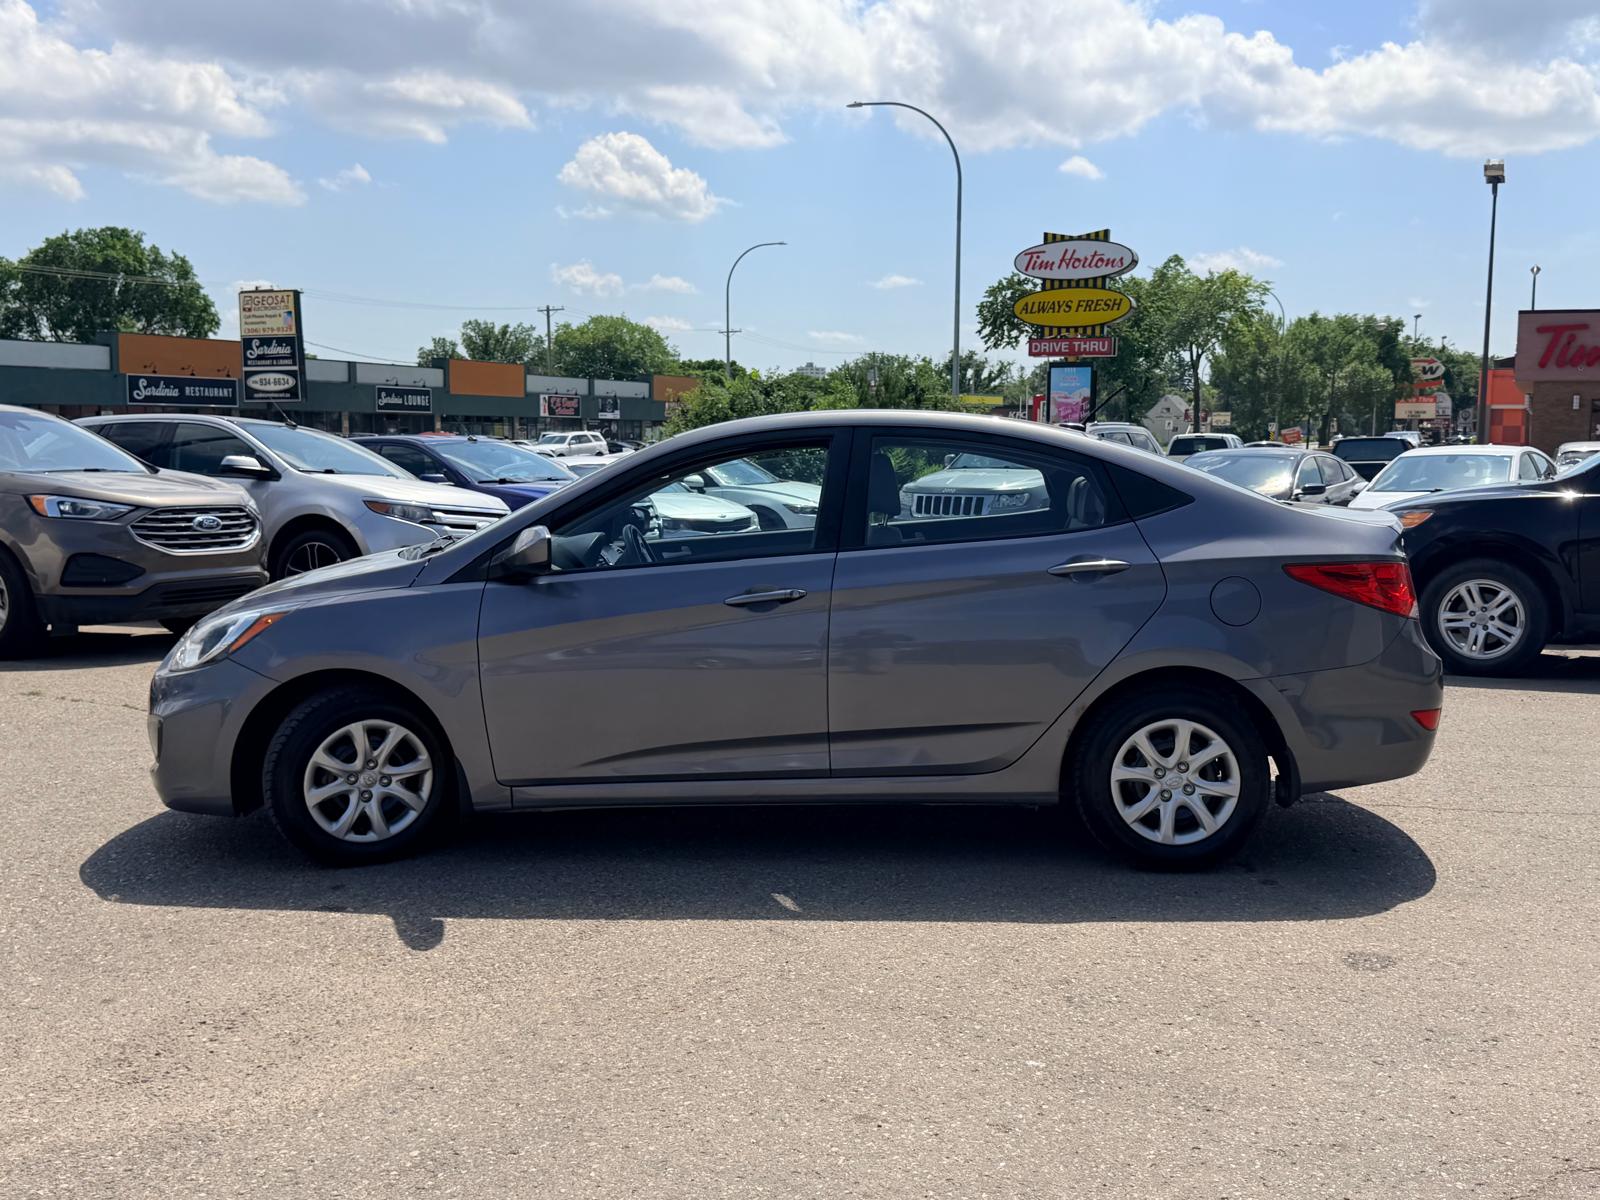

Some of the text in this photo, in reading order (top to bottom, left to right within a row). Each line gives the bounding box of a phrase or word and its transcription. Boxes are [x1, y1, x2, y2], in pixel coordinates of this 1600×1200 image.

[1023, 248, 1124, 272] Tim Hortons
[253, 294, 291, 306] GEOSAT
[1019, 298, 1123, 315] ALWAYS FRESH
[247, 338, 292, 359] Sardinia
[1032, 341, 1108, 353] DRIVE THRU
[133, 378, 232, 400] Sardinia RESTAURANT
[404, 394, 430, 406] LOUNGE
